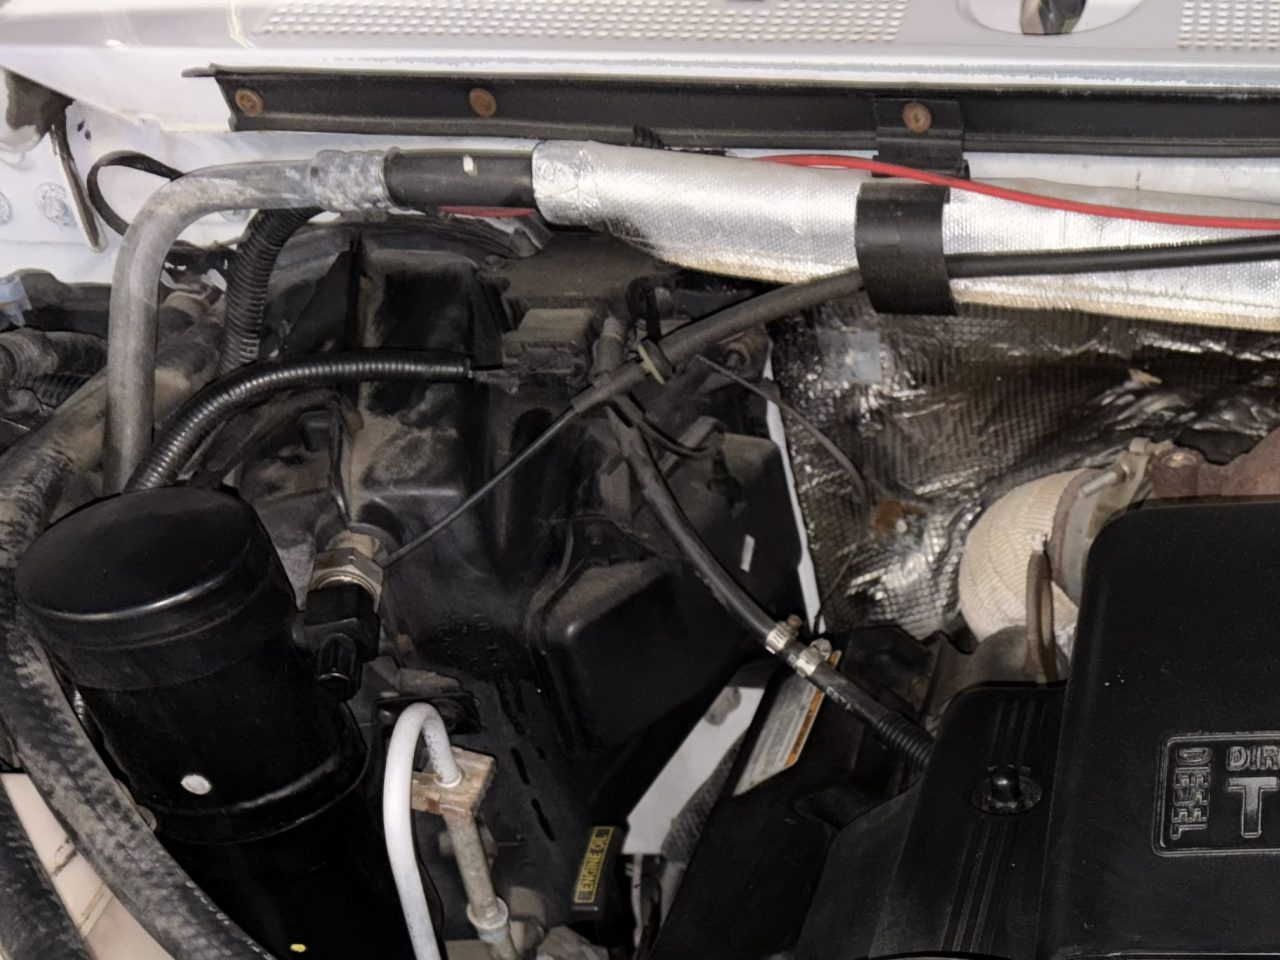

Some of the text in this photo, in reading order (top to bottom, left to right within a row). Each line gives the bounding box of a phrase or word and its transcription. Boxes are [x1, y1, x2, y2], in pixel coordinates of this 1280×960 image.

[1170, 747, 1213, 840] DIESEL
[580, 835, 608, 891] ENGINE OIL
